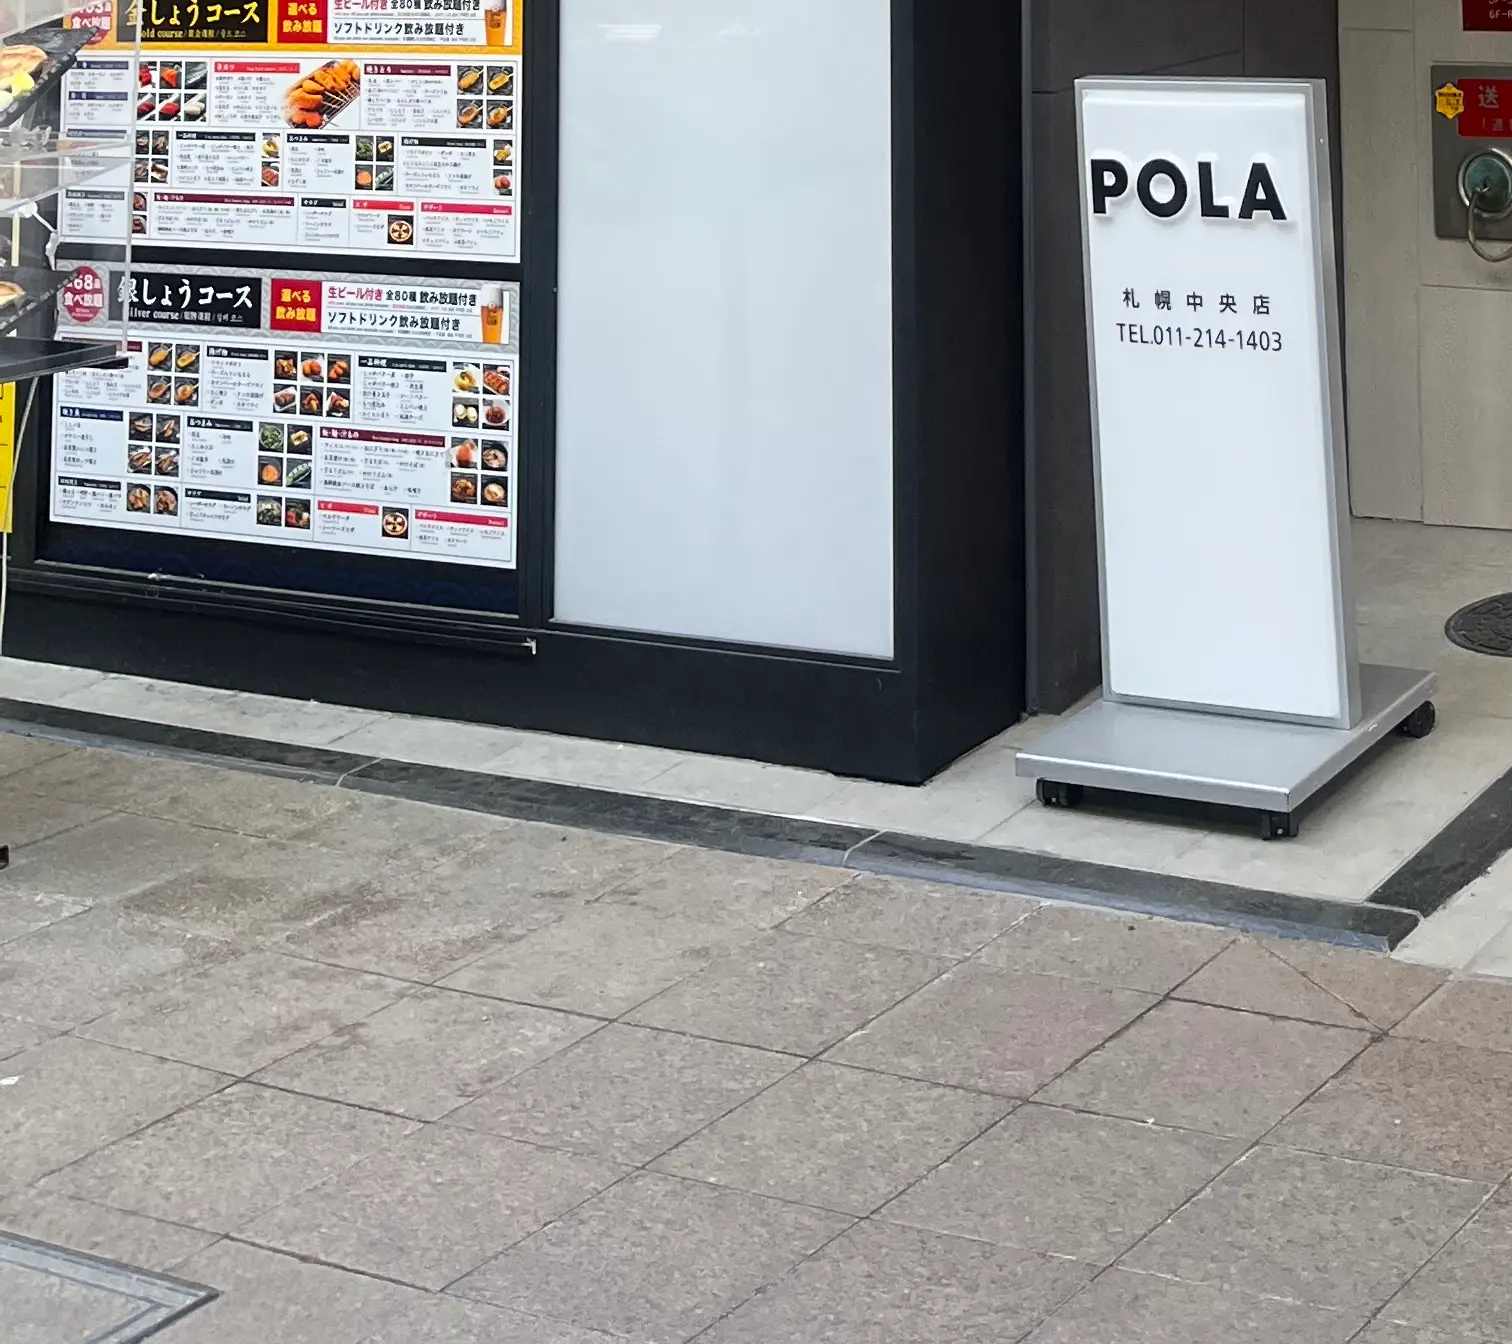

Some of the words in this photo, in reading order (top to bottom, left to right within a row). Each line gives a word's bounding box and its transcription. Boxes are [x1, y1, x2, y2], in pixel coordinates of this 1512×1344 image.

[287, 2, 318, 16] 選べる
[282, 19, 323, 34] 飲み放題
[333, 21, 464, 37] ソフトドリンク飲み放題付き
[1090, 158, 1288, 221] POLA
[64, 291, 103, 308] 食べ放題
[117, 276, 253, 309] 銀しょうコース
[280, 287, 311, 304] 選べる
[327, 285, 383, 302] 生ビール付き
[419, 290, 477, 307] 飲み放題付き
[1122, 287, 1270, 315] 札幌中央店
[275, 305, 317, 323] 飲み放題
[327, 311, 461, 332] ソフトドリンク飲み放題付き
[1116, 322, 1283, 352] TEL.011-214-1403
